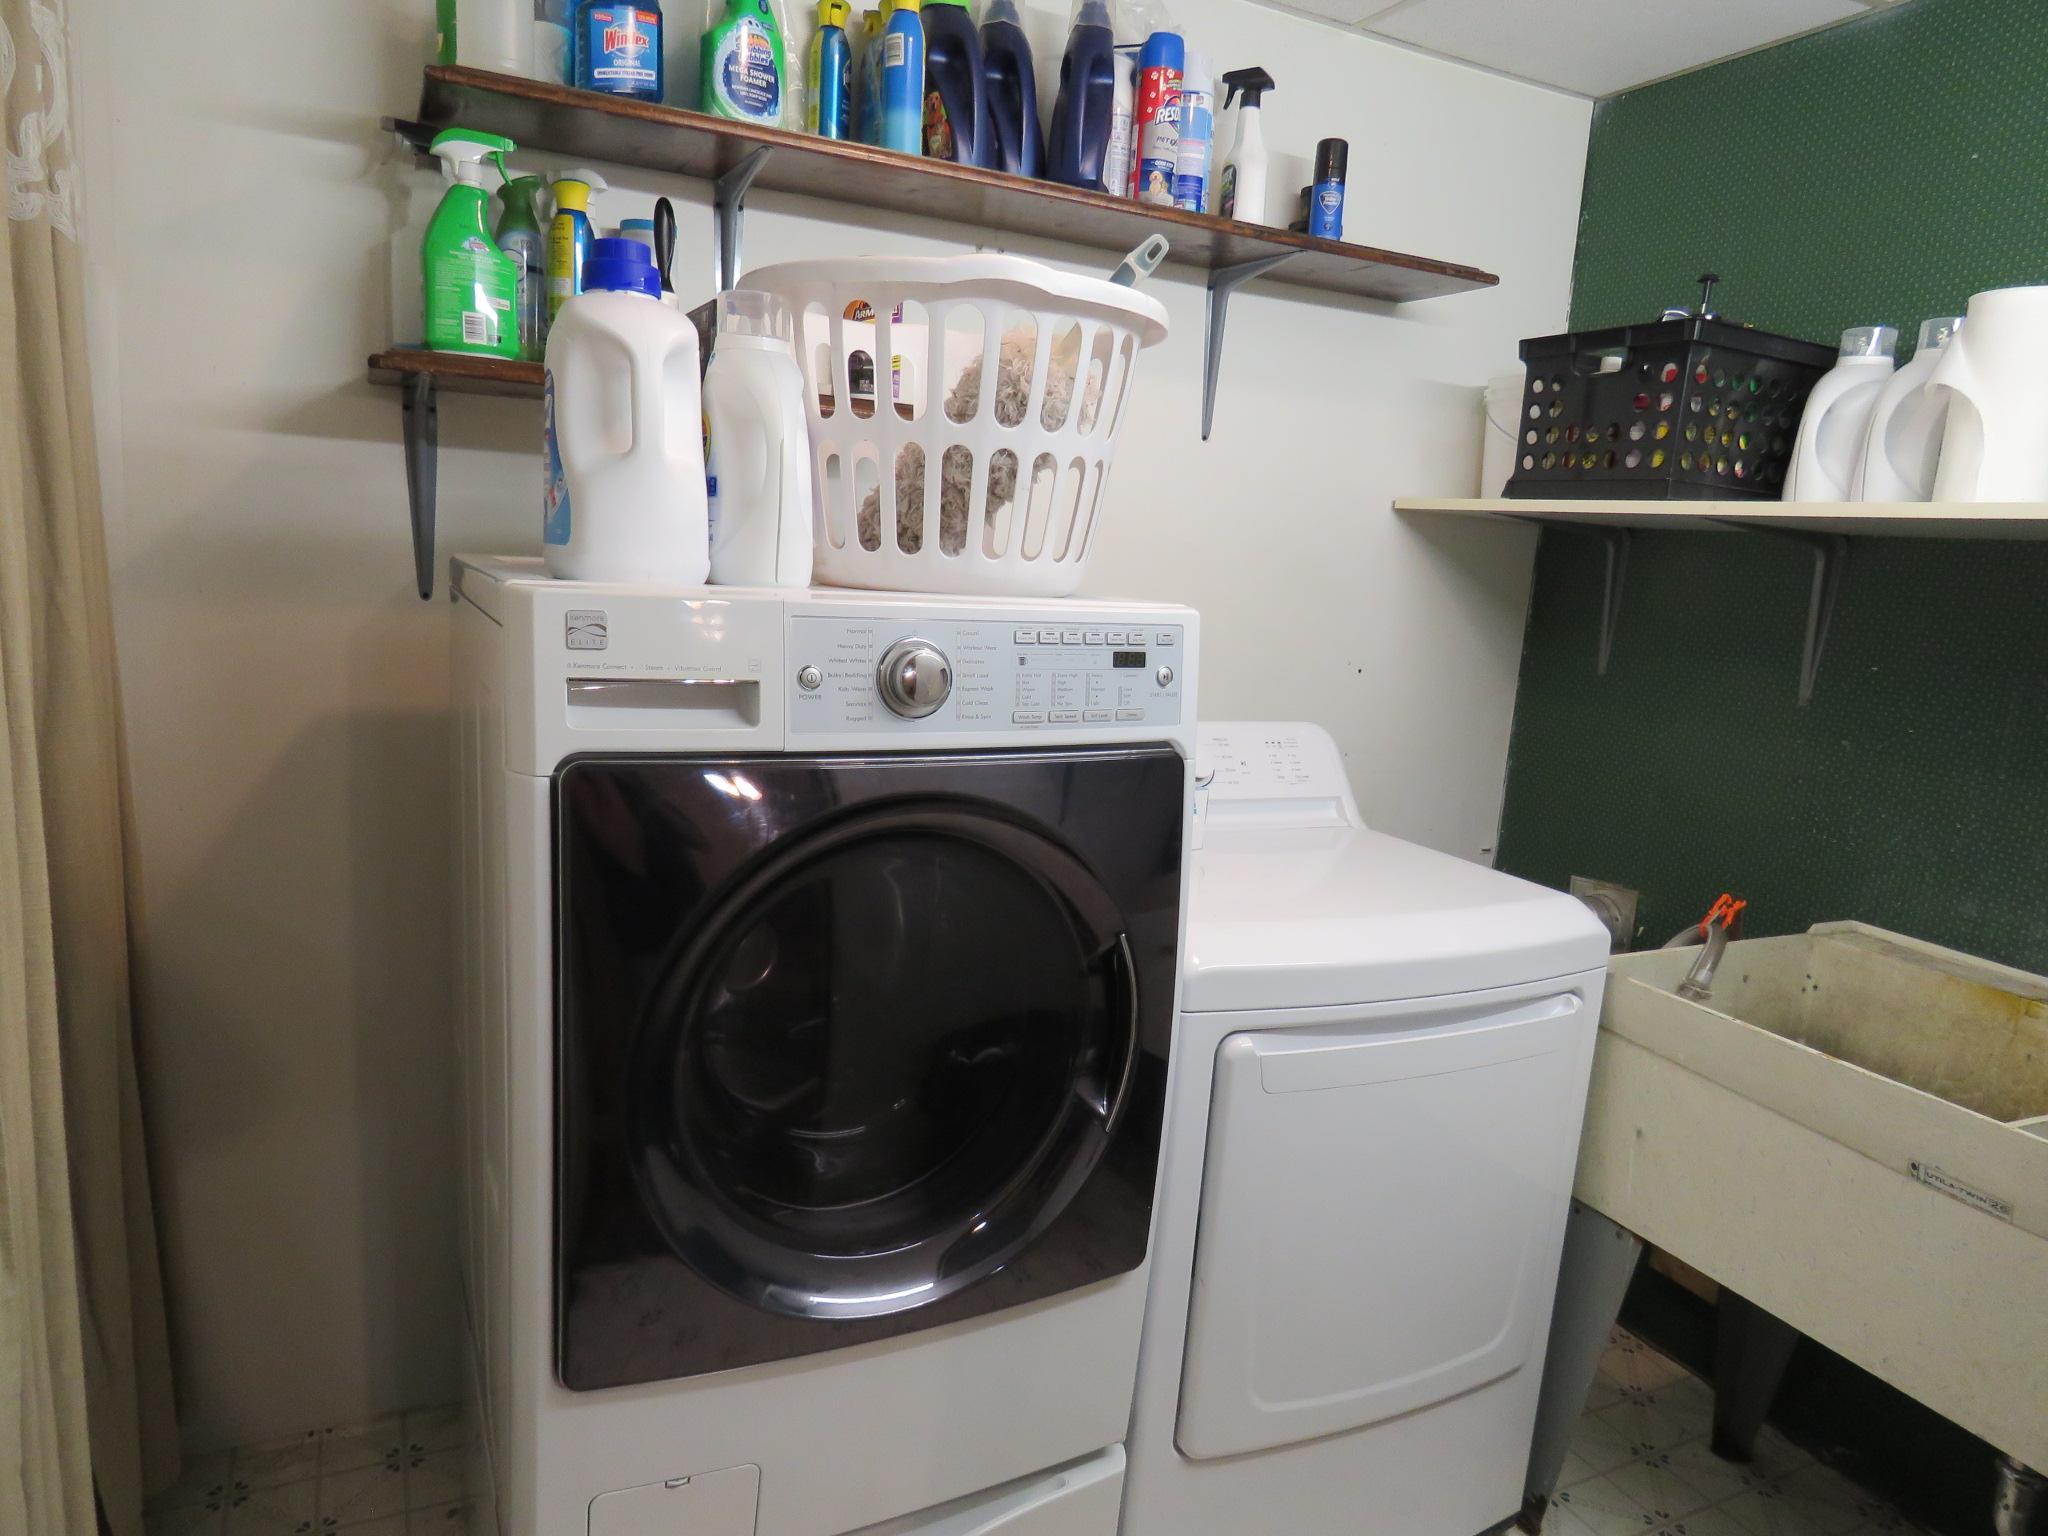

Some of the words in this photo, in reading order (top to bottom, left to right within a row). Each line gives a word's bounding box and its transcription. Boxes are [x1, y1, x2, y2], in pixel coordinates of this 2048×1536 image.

[604, 27, 649, 54] Winex
[728, 64, 750, 75] MEGA
[749, 69, 775, 84] SHOWER
[740, 75, 767, 88] FOAMER
[1155, 106, 1181, 125] RESO
[855, 308, 874, 321] ARM
[569, 639, 604, 647] ELITE
[799, 693, 822, 701] POWER
